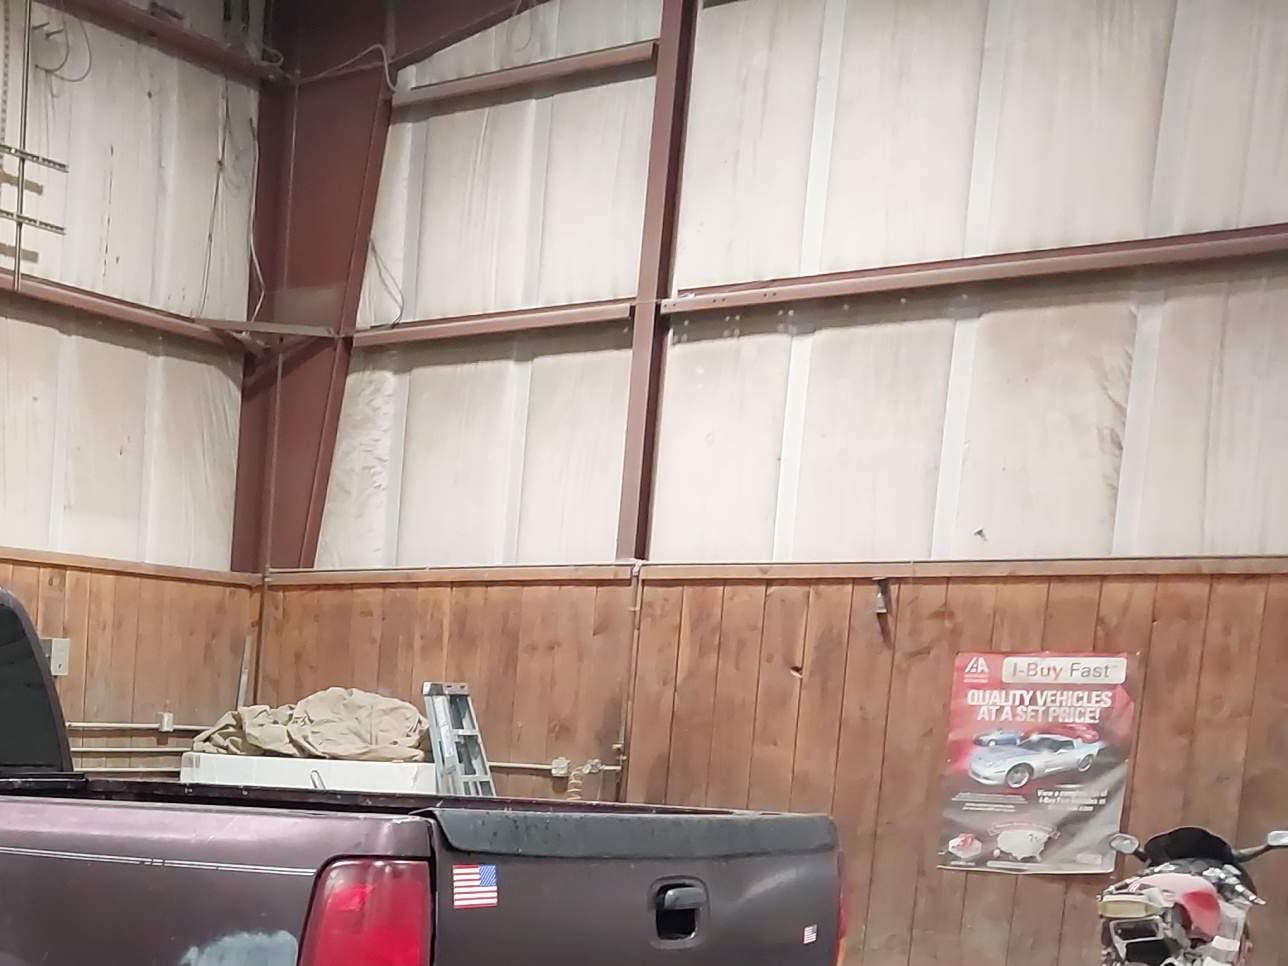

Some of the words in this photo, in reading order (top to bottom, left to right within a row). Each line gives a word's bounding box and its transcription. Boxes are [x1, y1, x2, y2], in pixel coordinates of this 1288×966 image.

[1013, 662, 1063, 680] I-Buy
[967, 689, 1034, 706] QUALITY
[1035, 690, 1113, 708] VEHICLES
[977, 705, 1000, 721] AT
[1000, 706, 1013, 721] A
[1015, 706, 1047, 722] SET
[1048, 706, 1102, 724] PRICE!
